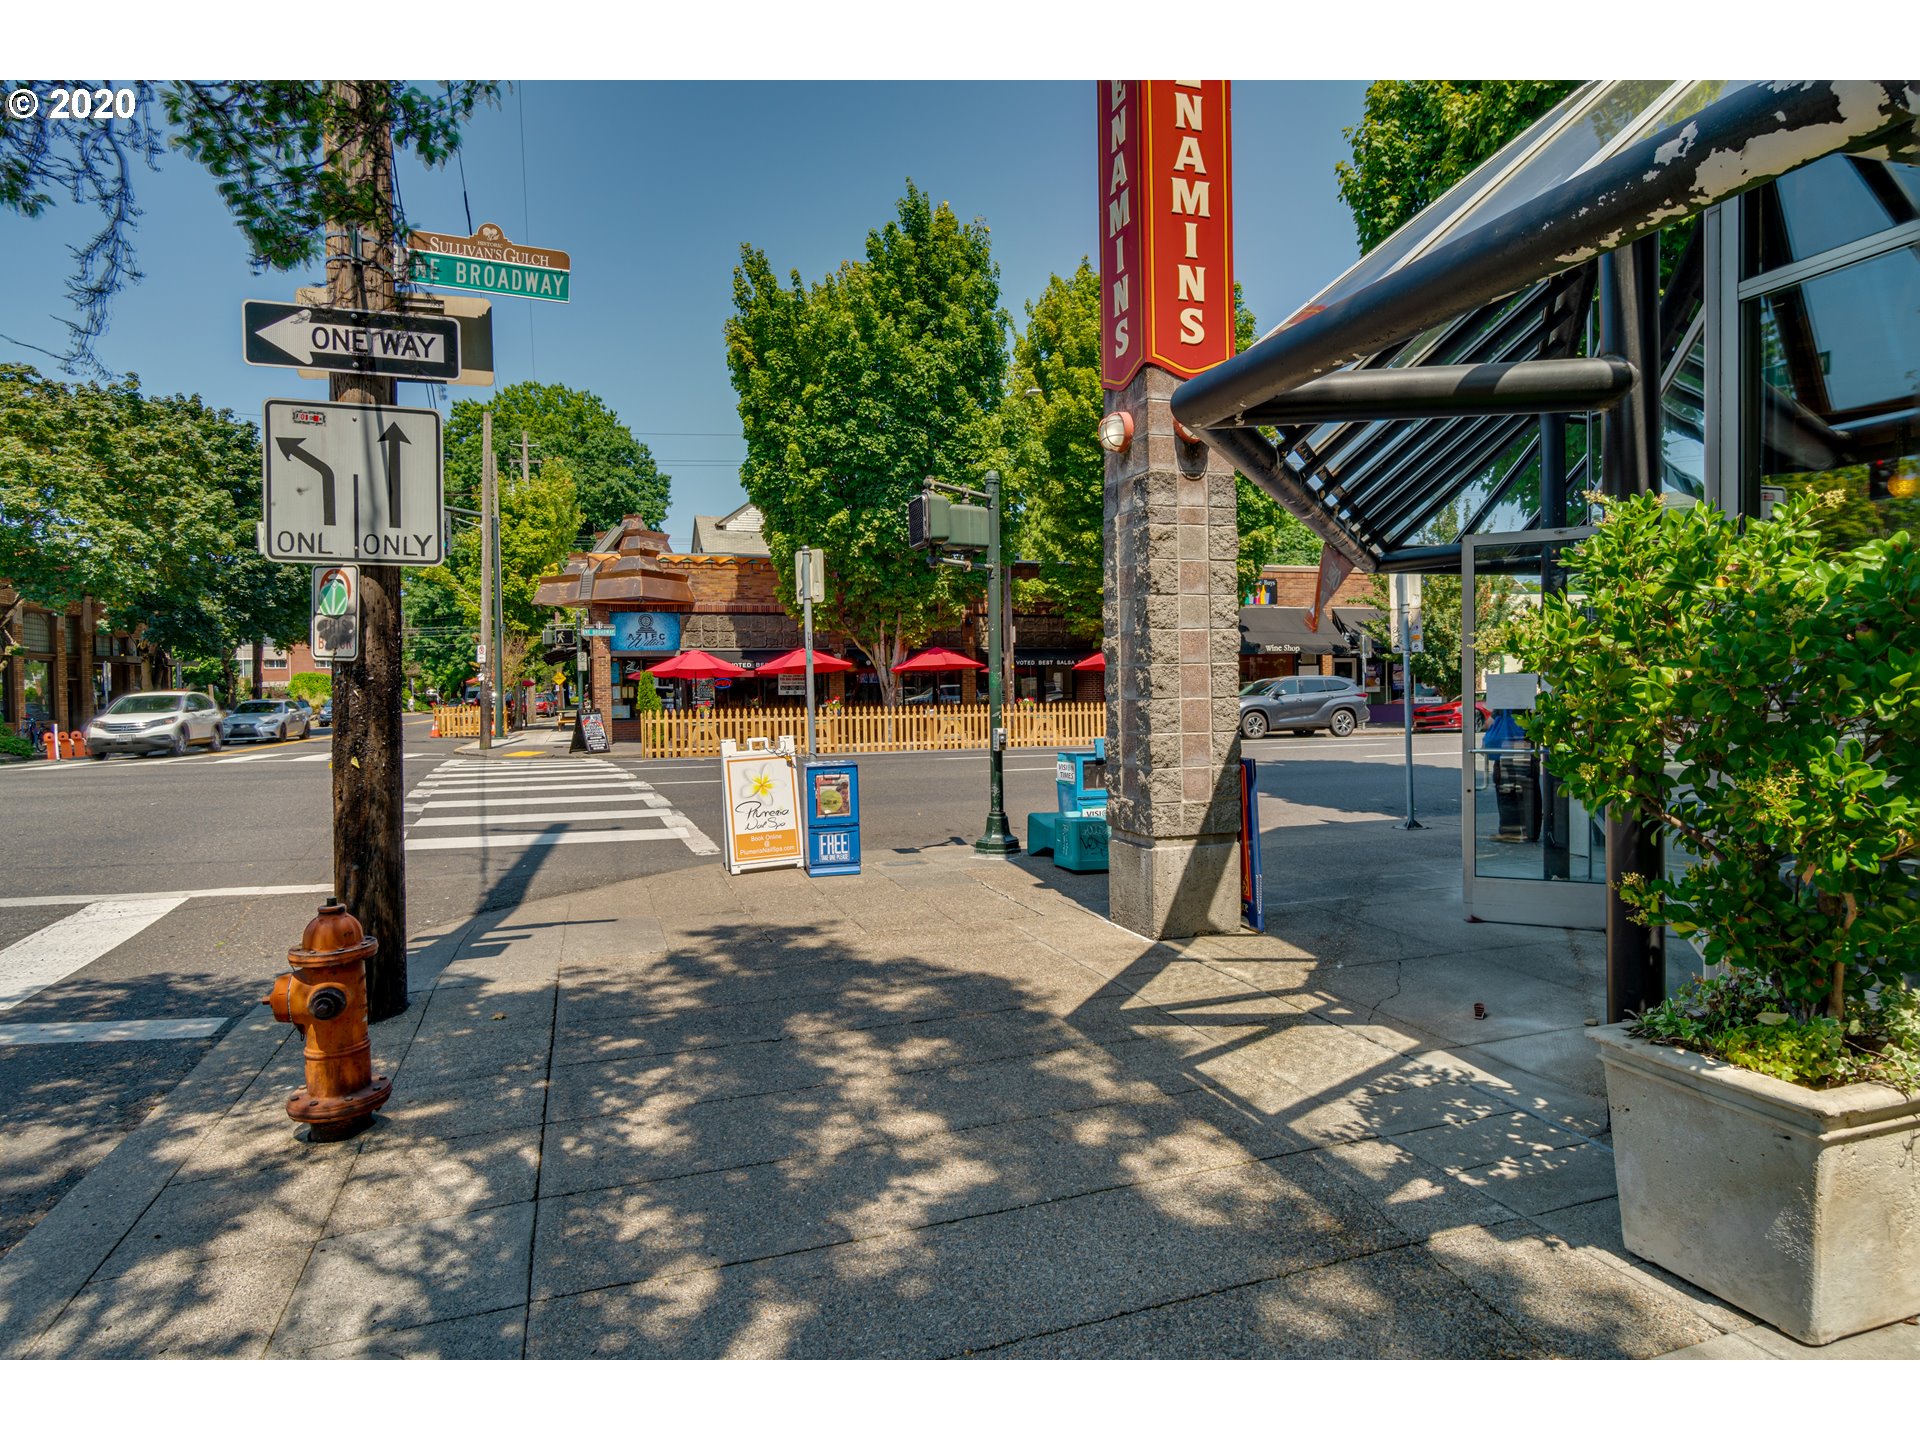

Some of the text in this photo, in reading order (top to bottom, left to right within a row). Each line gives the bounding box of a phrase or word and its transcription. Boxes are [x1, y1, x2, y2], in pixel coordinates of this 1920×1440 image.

[1171, 80, 1211, 345] NAMINS
[429, 236, 549, 267] SULLIVAN'S GULCH
[477, 240, 504, 249] HISTORIC
[414, 257, 565, 296] NE BROADWAY
[311, 326, 436, 359] ONE WAY
[363, 533, 433, 557] ONLY
[626, 632, 666, 641] AZTEC
[1265, 644, 1301, 653] Wine Shop
[1058, 763, 1074, 771] VISION
[1060, 772, 1074, 780] TIMES
[768, 817, 786, 829] Spa
[820, 833, 849, 855] FREE
